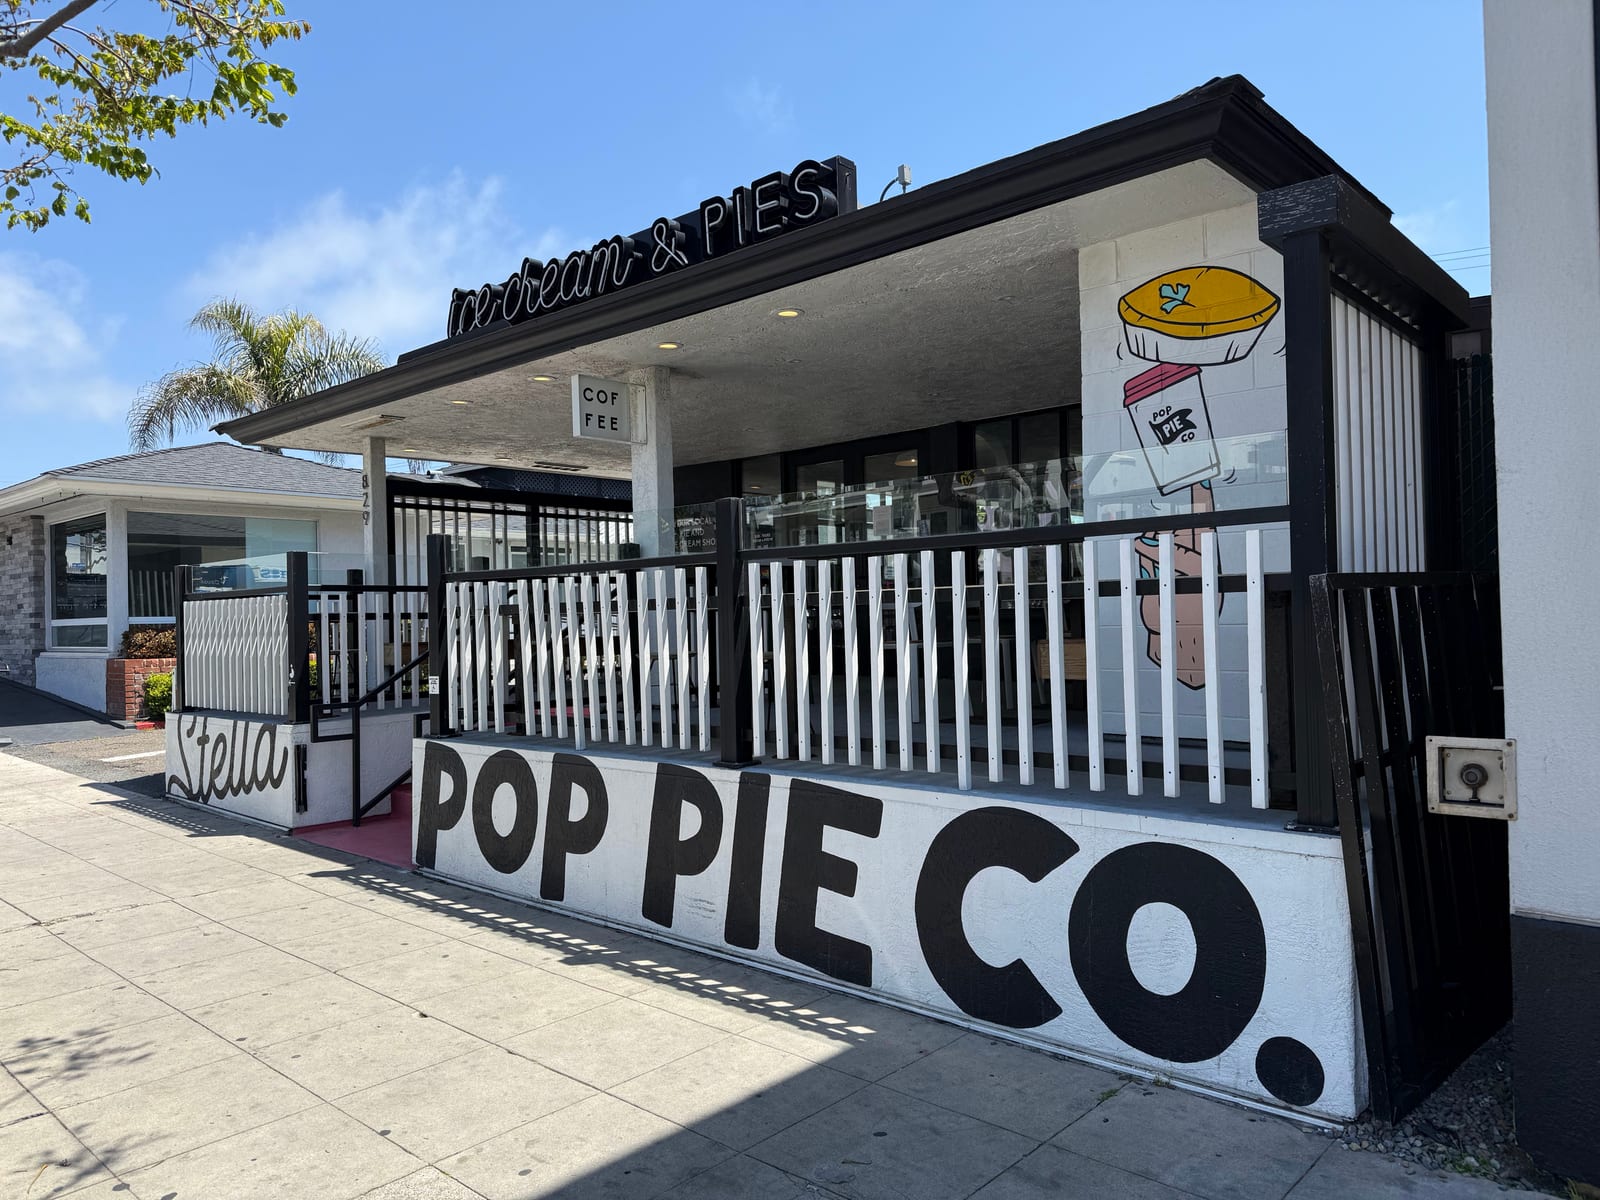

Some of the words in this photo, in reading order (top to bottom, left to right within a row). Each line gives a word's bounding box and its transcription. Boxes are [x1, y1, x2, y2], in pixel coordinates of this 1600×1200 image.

[447, 287, 501, 338] ice
[502, 235, 638, 321] cream
[650, 218, 687, 273] &
[700, 160, 833, 259] PIES
[583, 387, 619, 406] COF
[585, 412, 619, 431] FEE
[1152, 405, 1172, 422] POP
[1162, 415, 1184, 438] PIE
[1181, 431, 1195, 443] CO
[362, 474, 370, 526] 829
[702, 537, 716, 547] SHO
[167, 714, 288, 804] Stella
[415, 741, 609, 901] POP
[642, 763, 884, 988] PIE
[914, 805, 1325, 1106] CO.
